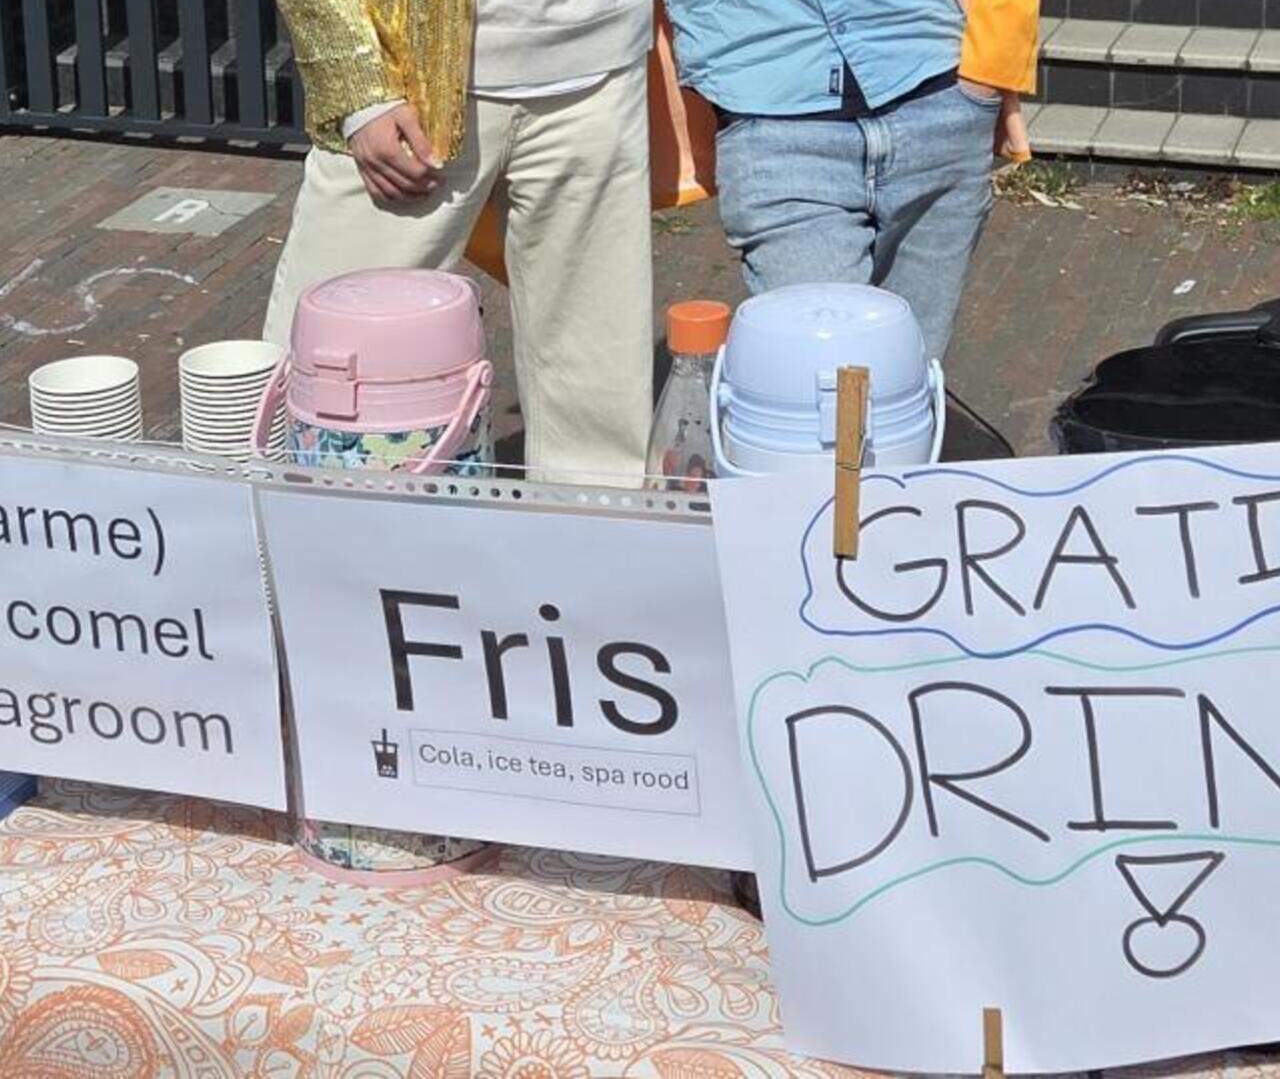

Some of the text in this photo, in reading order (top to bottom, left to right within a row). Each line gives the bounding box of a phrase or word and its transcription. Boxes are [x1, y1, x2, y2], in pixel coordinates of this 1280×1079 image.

[379, 588, 680, 736] Fris
[419, 743, 690, 791] Cola, ice tea, spa rood
